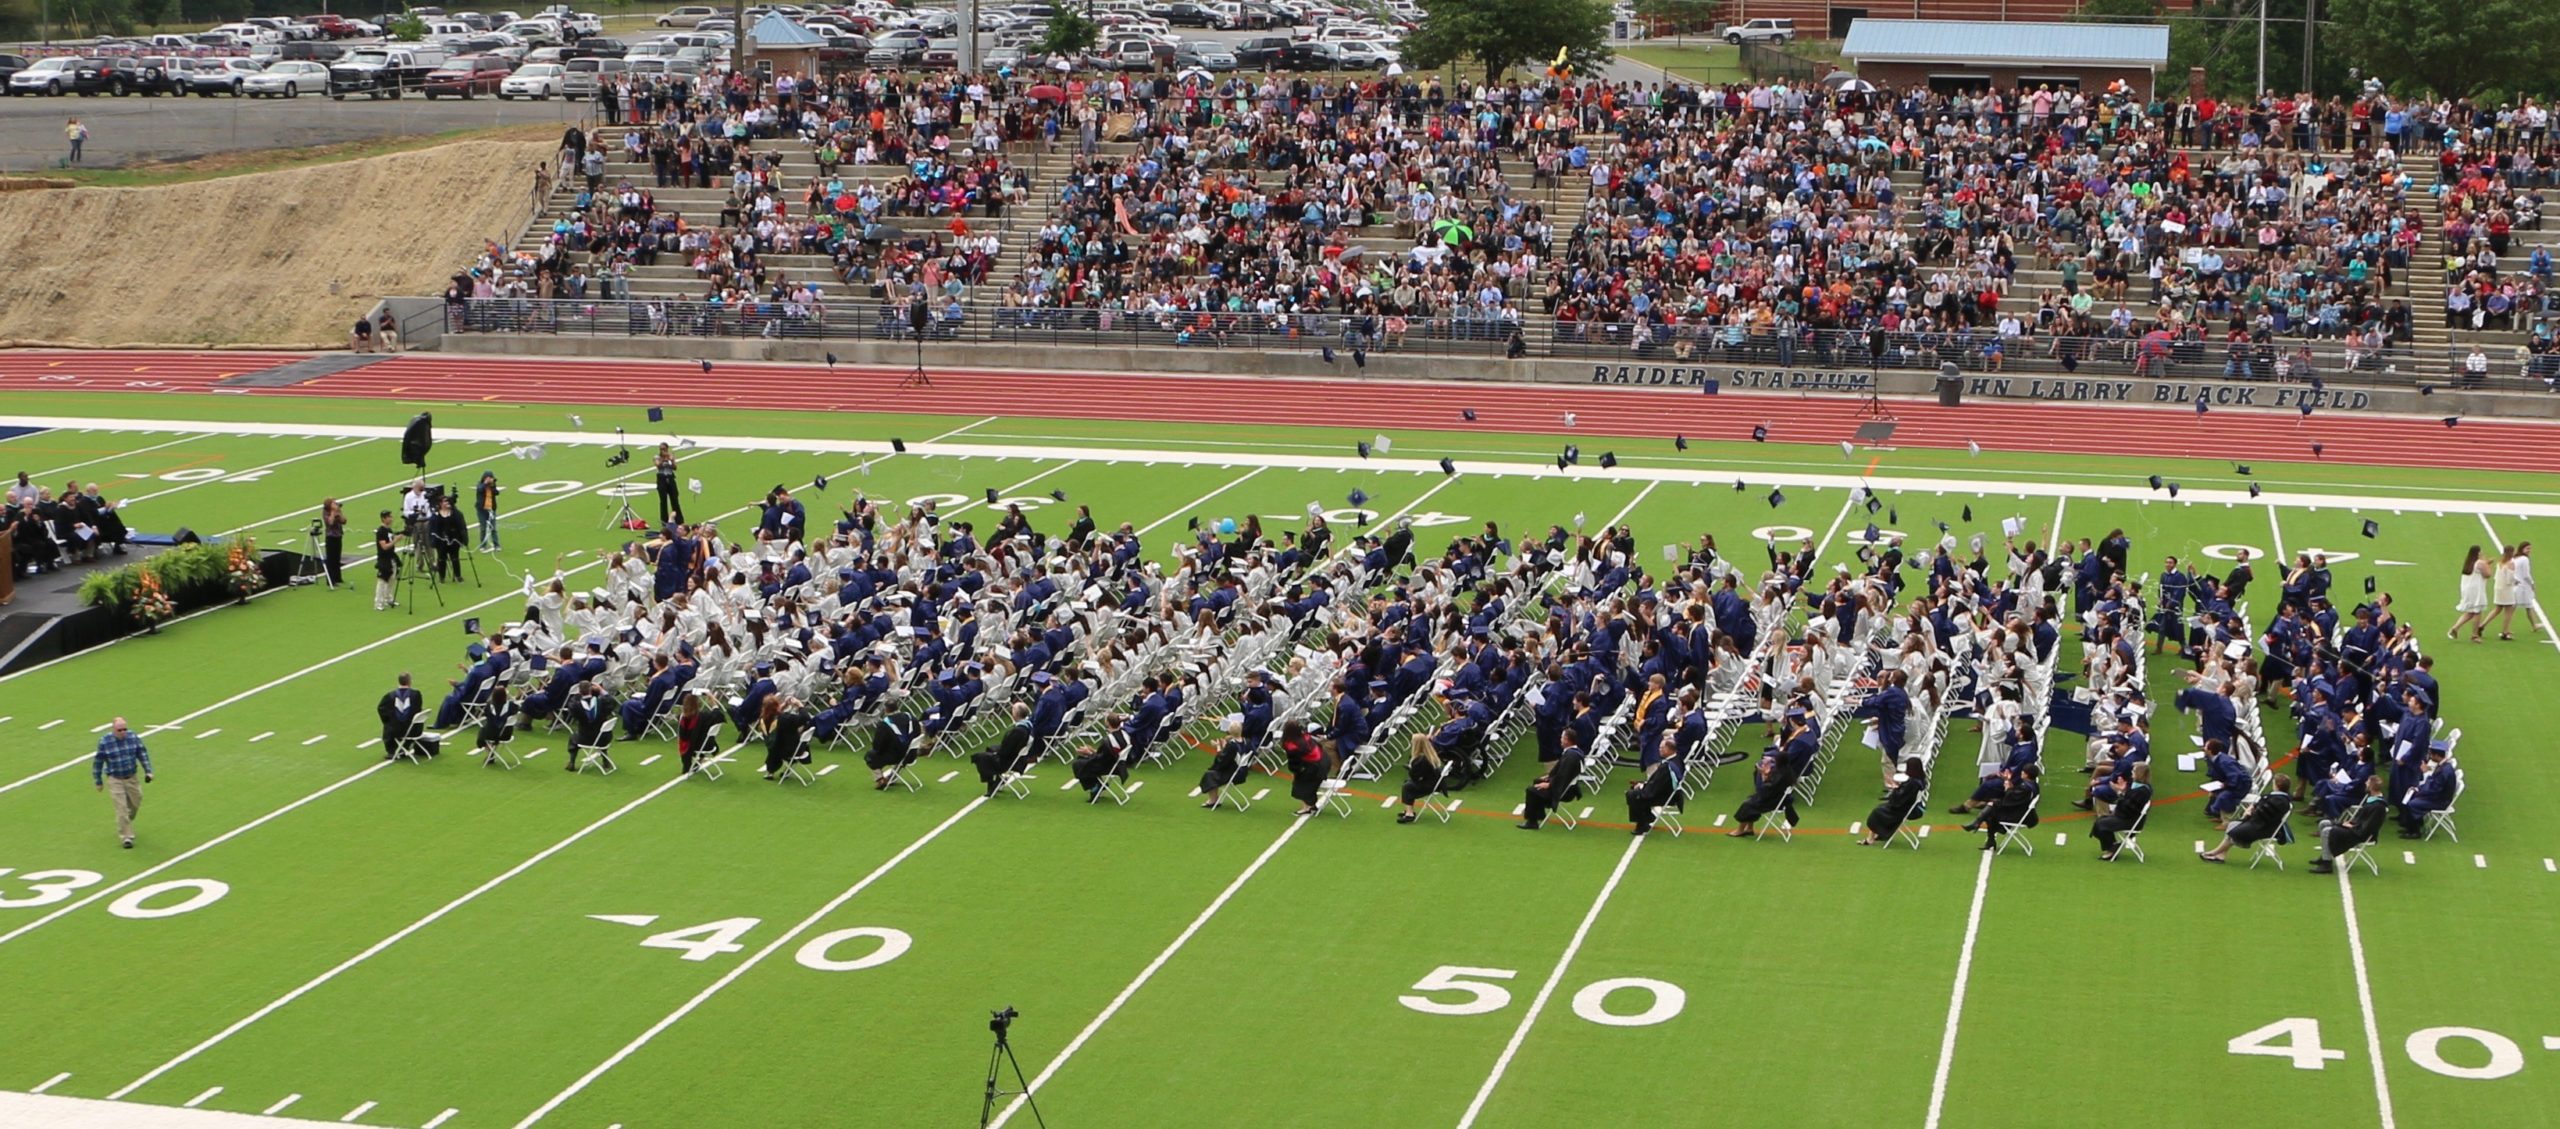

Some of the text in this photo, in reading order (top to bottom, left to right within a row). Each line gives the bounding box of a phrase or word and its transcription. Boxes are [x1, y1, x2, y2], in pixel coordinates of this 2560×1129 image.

[1592, 366, 1870, 391] RAIDER STADIUM
[2030, 380, 2133, 400] LARRY
[2154, 384, 2255, 404] BLACK
[2275, 389, 2369, 409] FIELD
